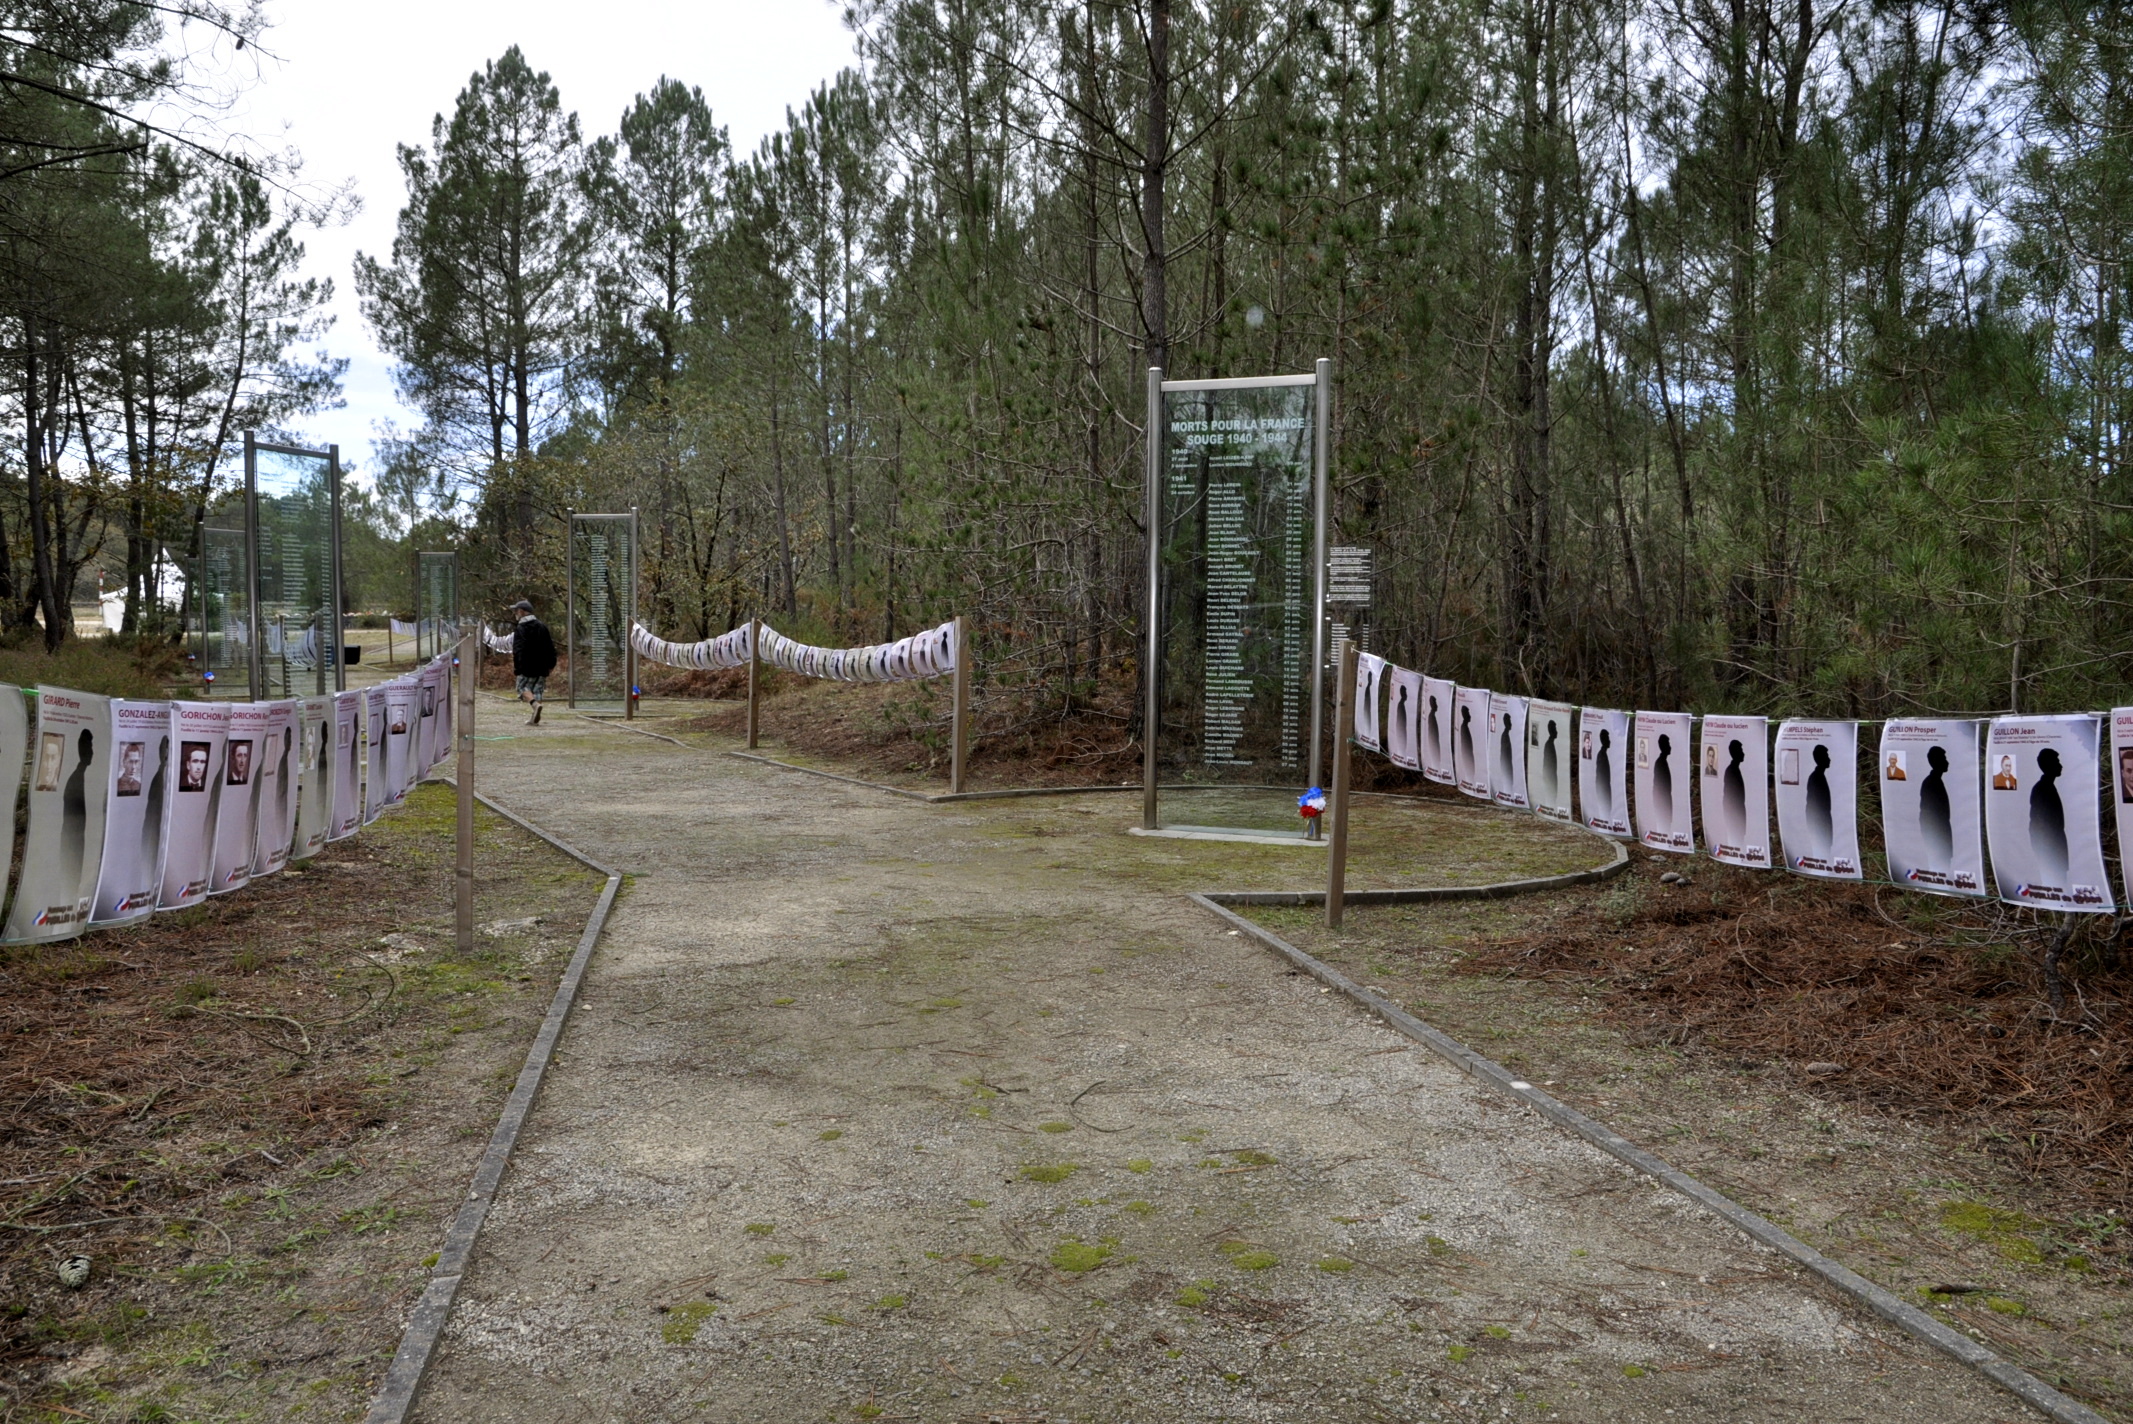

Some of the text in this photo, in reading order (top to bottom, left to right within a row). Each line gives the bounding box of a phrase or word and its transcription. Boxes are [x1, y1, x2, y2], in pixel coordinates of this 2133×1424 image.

[1171, 418, 1305, 432] MORTS POUR LA FRANCE
[1187, 434, 1225, 446] SOUGE
[1227, 433, 1253, 444] 1940
[1262, 432, 1288, 443] 1944
[43, 694, 65, 706] GIRARD
[181, 711, 222, 720] GORICHON
